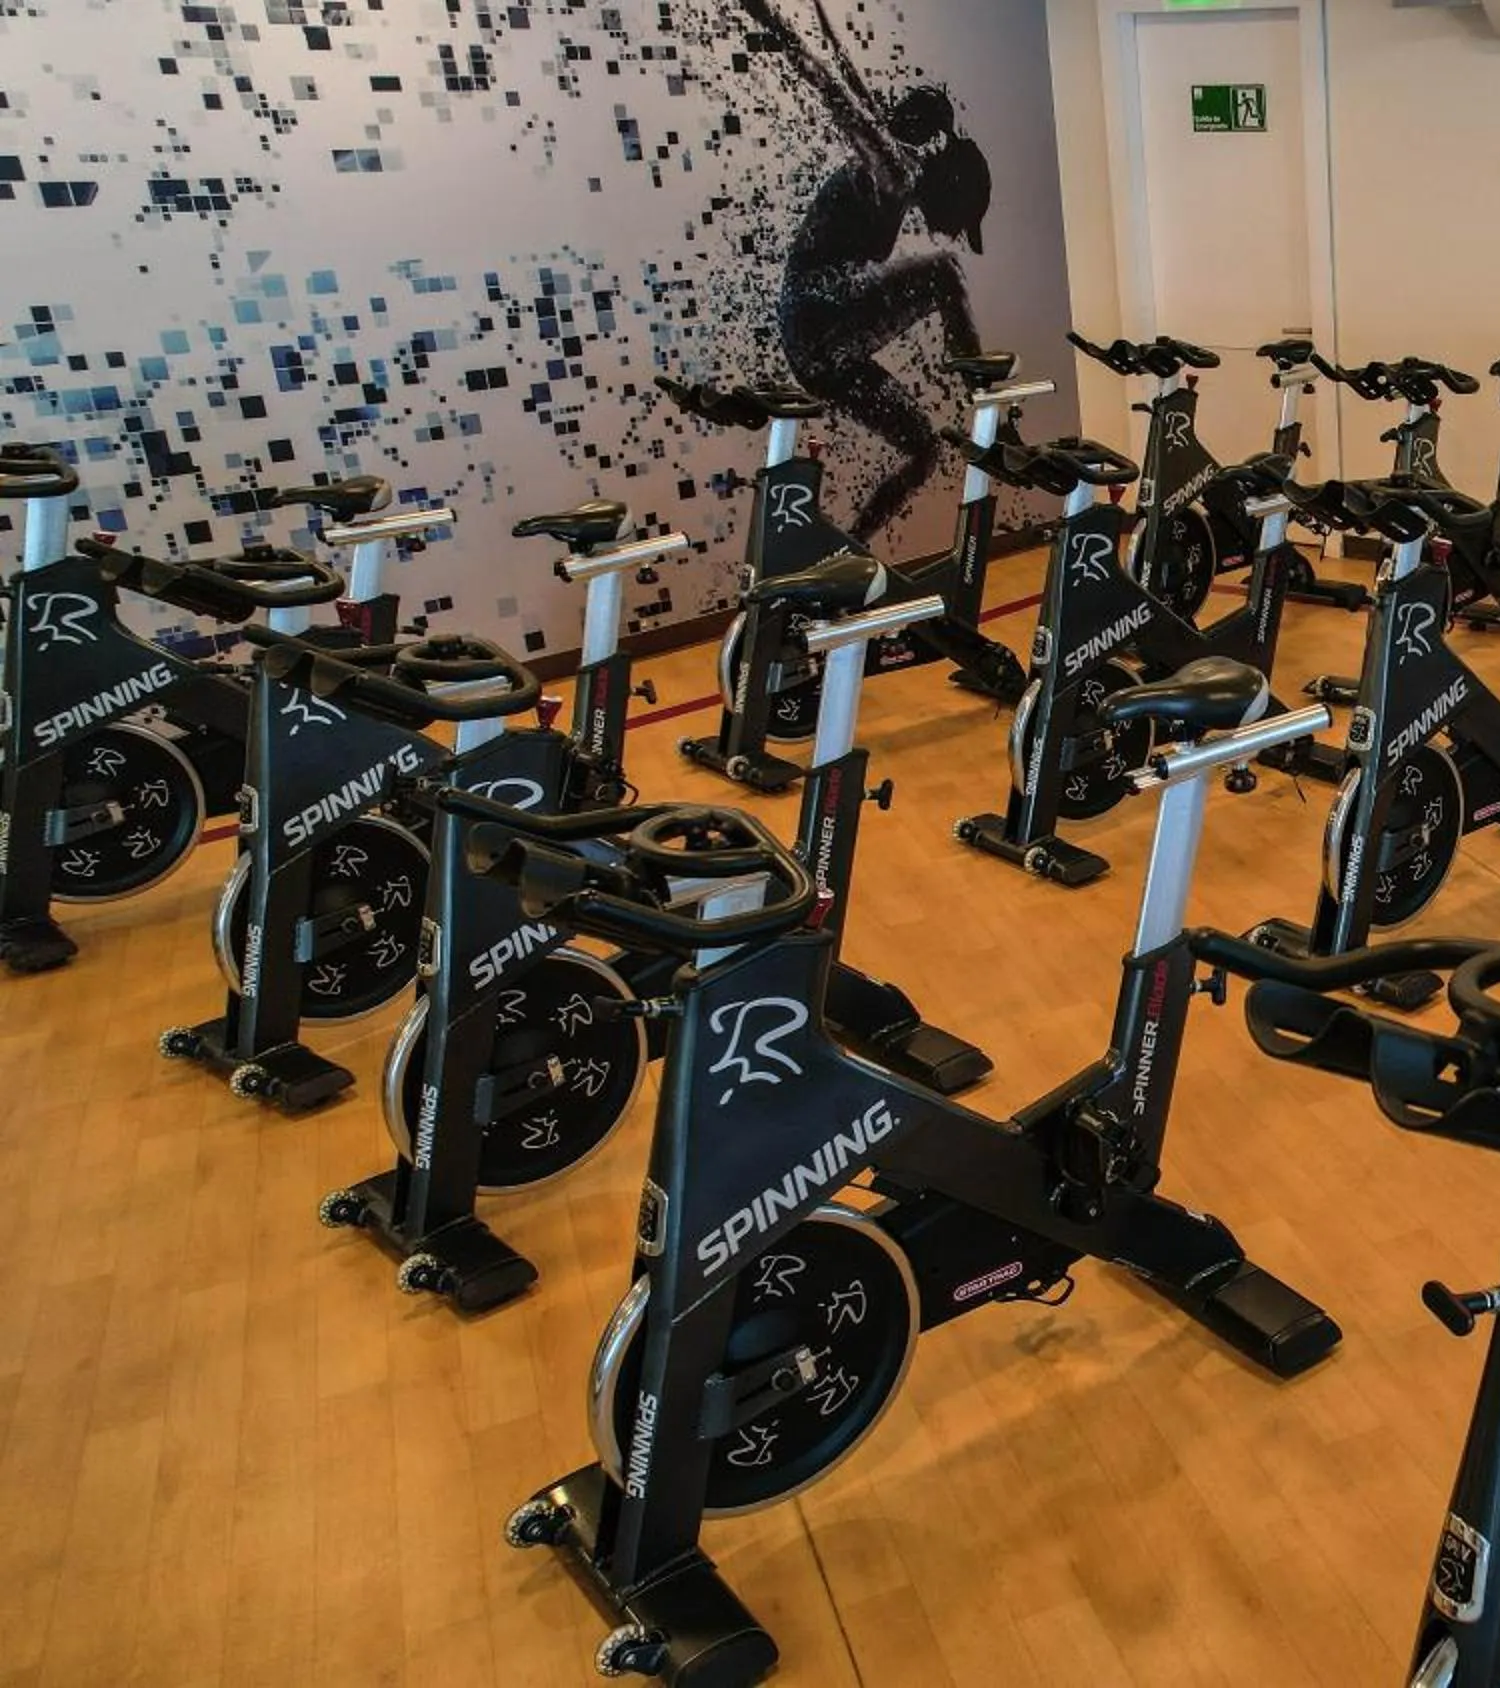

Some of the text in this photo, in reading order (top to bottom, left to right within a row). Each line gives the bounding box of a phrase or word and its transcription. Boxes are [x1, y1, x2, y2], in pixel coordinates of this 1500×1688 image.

[1064, 601, 1153, 676] SPINNING
[33, 662, 175, 747] SPINNING
[1387, 675, 1469, 767] SPINNING
[469, 922, 558, 991] SPIN
[1133, 1020, 1160, 1116] SPINNER
[415, 1083, 440, 1171] SPINNING
[697, 1099, 898, 1278] SPINNING
[624, 1390, 658, 1500] SPINNING
